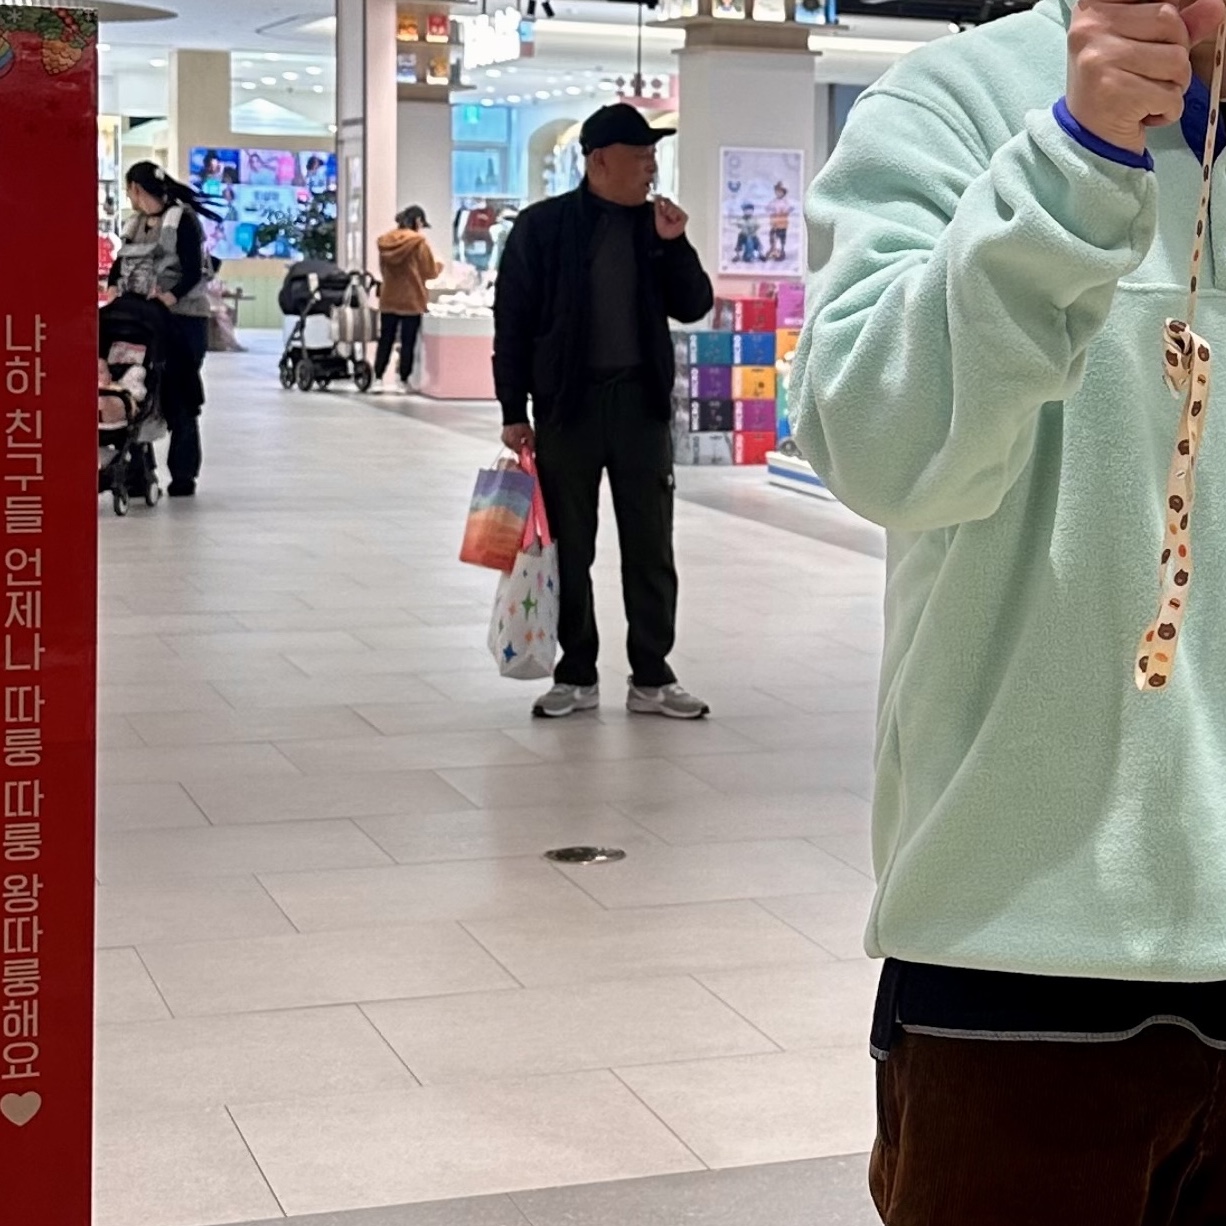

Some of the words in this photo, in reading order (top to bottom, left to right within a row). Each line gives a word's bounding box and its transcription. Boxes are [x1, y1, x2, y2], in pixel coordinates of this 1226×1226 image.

[5, 314, 47, 396] 냐하
[4, 409, 44, 534] 친구들
[4, 548, 46, 672] 언제나
